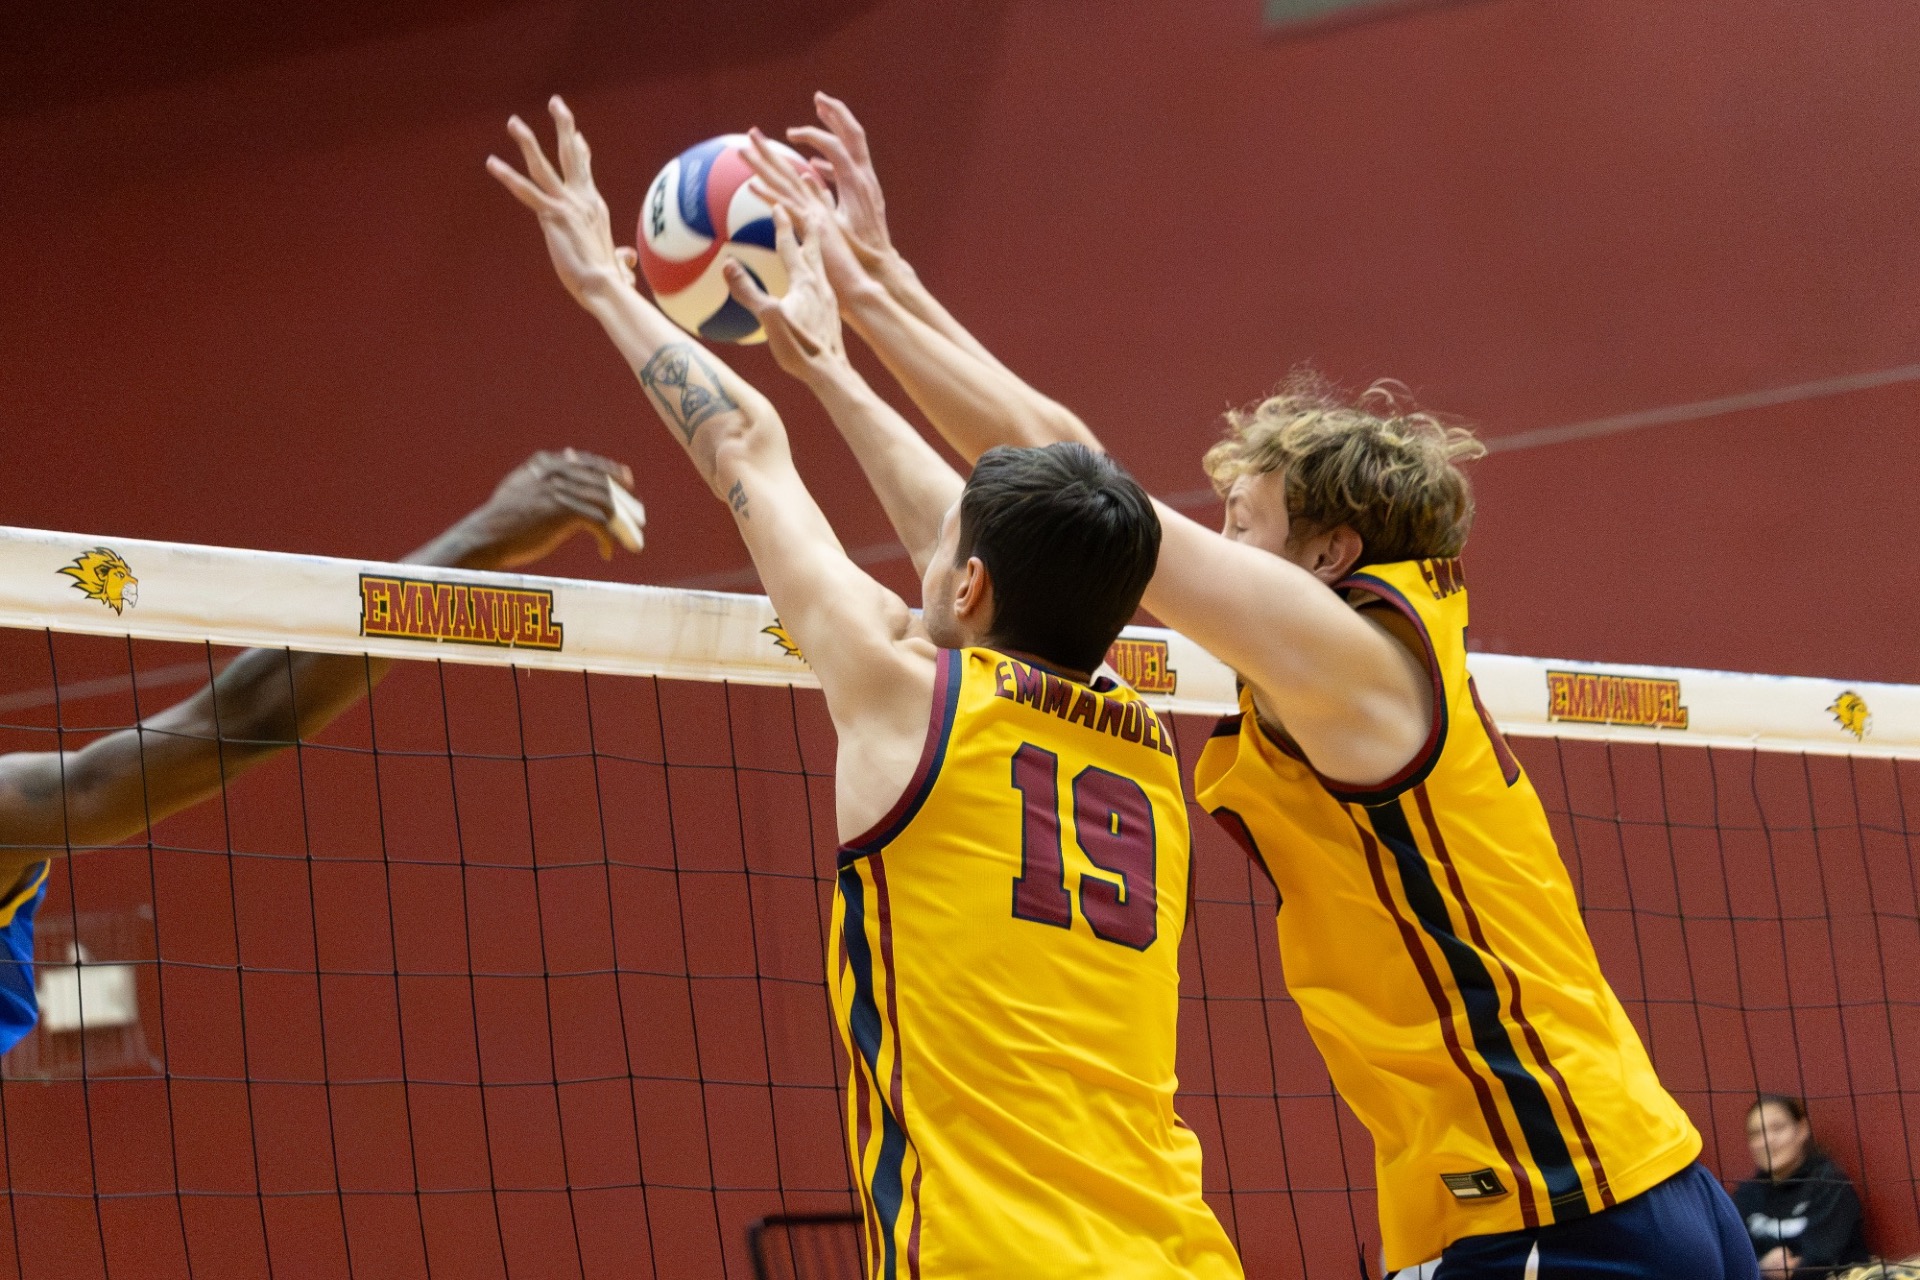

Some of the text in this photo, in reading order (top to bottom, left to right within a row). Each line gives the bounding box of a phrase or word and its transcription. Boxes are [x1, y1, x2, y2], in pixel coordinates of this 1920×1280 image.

[360, 574, 563, 651] EMMANUEL
[995, 660, 1172, 756] EMMANUEL
[1547, 670, 1688, 729] EMMANUEL
[1011, 741, 1158, 952] 19
